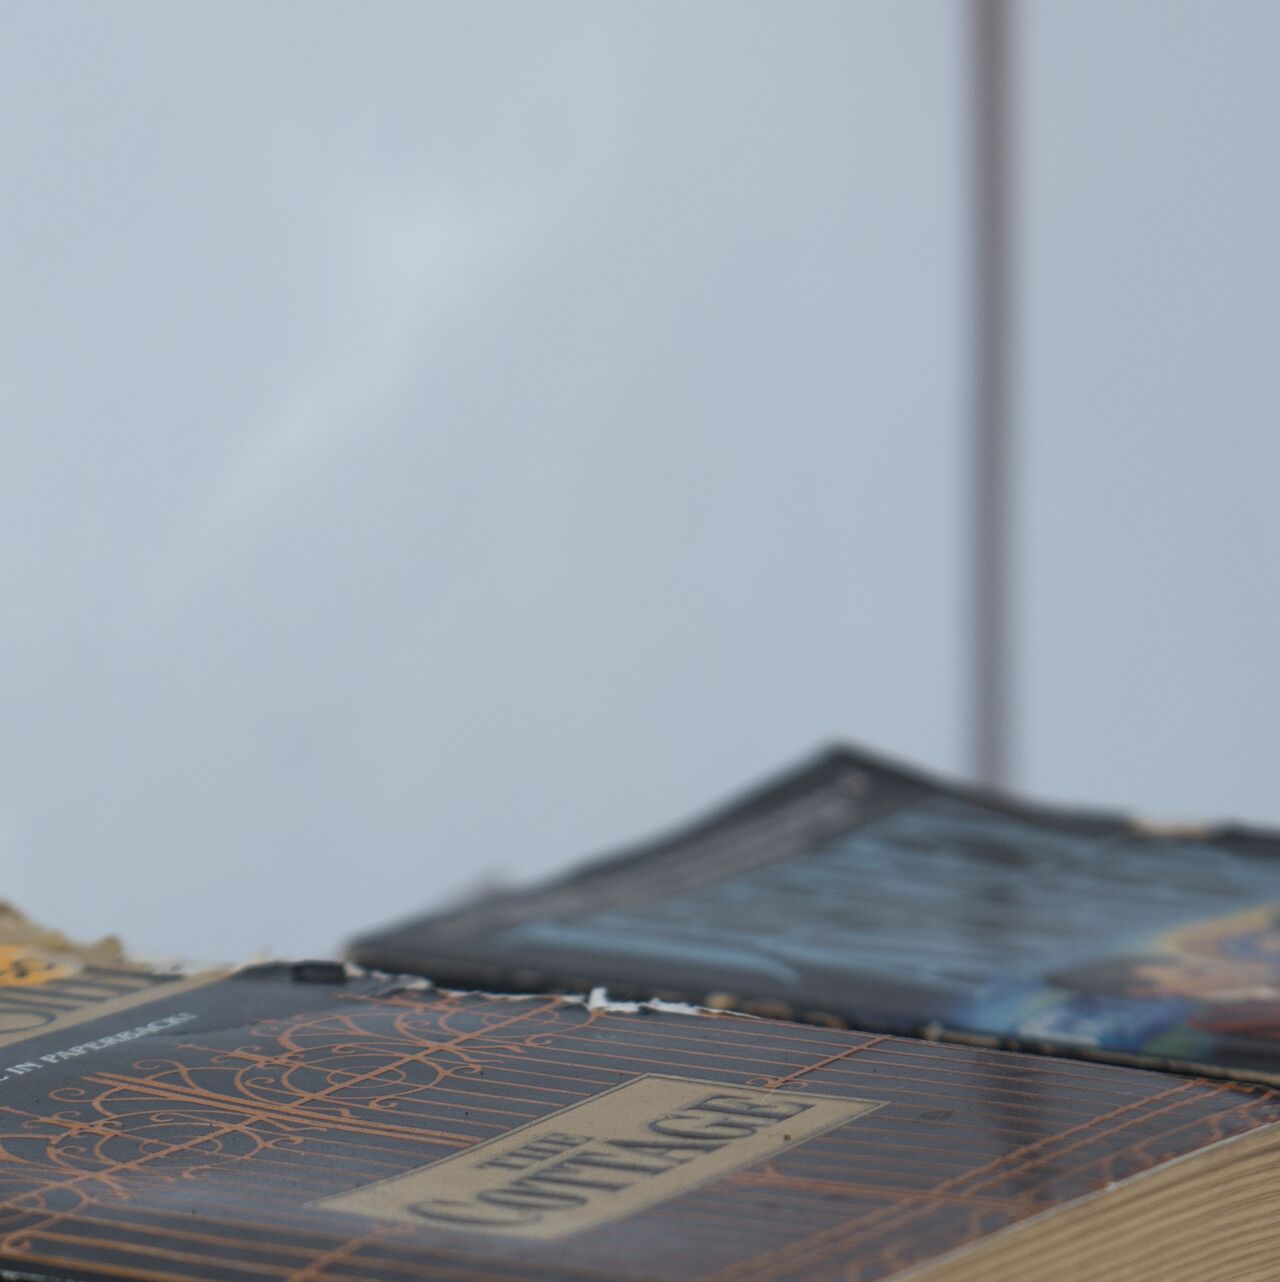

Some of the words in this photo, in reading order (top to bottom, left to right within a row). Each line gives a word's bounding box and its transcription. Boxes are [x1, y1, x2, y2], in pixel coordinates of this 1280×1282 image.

[7, 1060, 45, 1076] IN
[39, 1011, 199, 1064] PAPERBACK!
[405, 1093, 817, 1228] COTTAGE
[477, 1132, 593, 1170] THE
